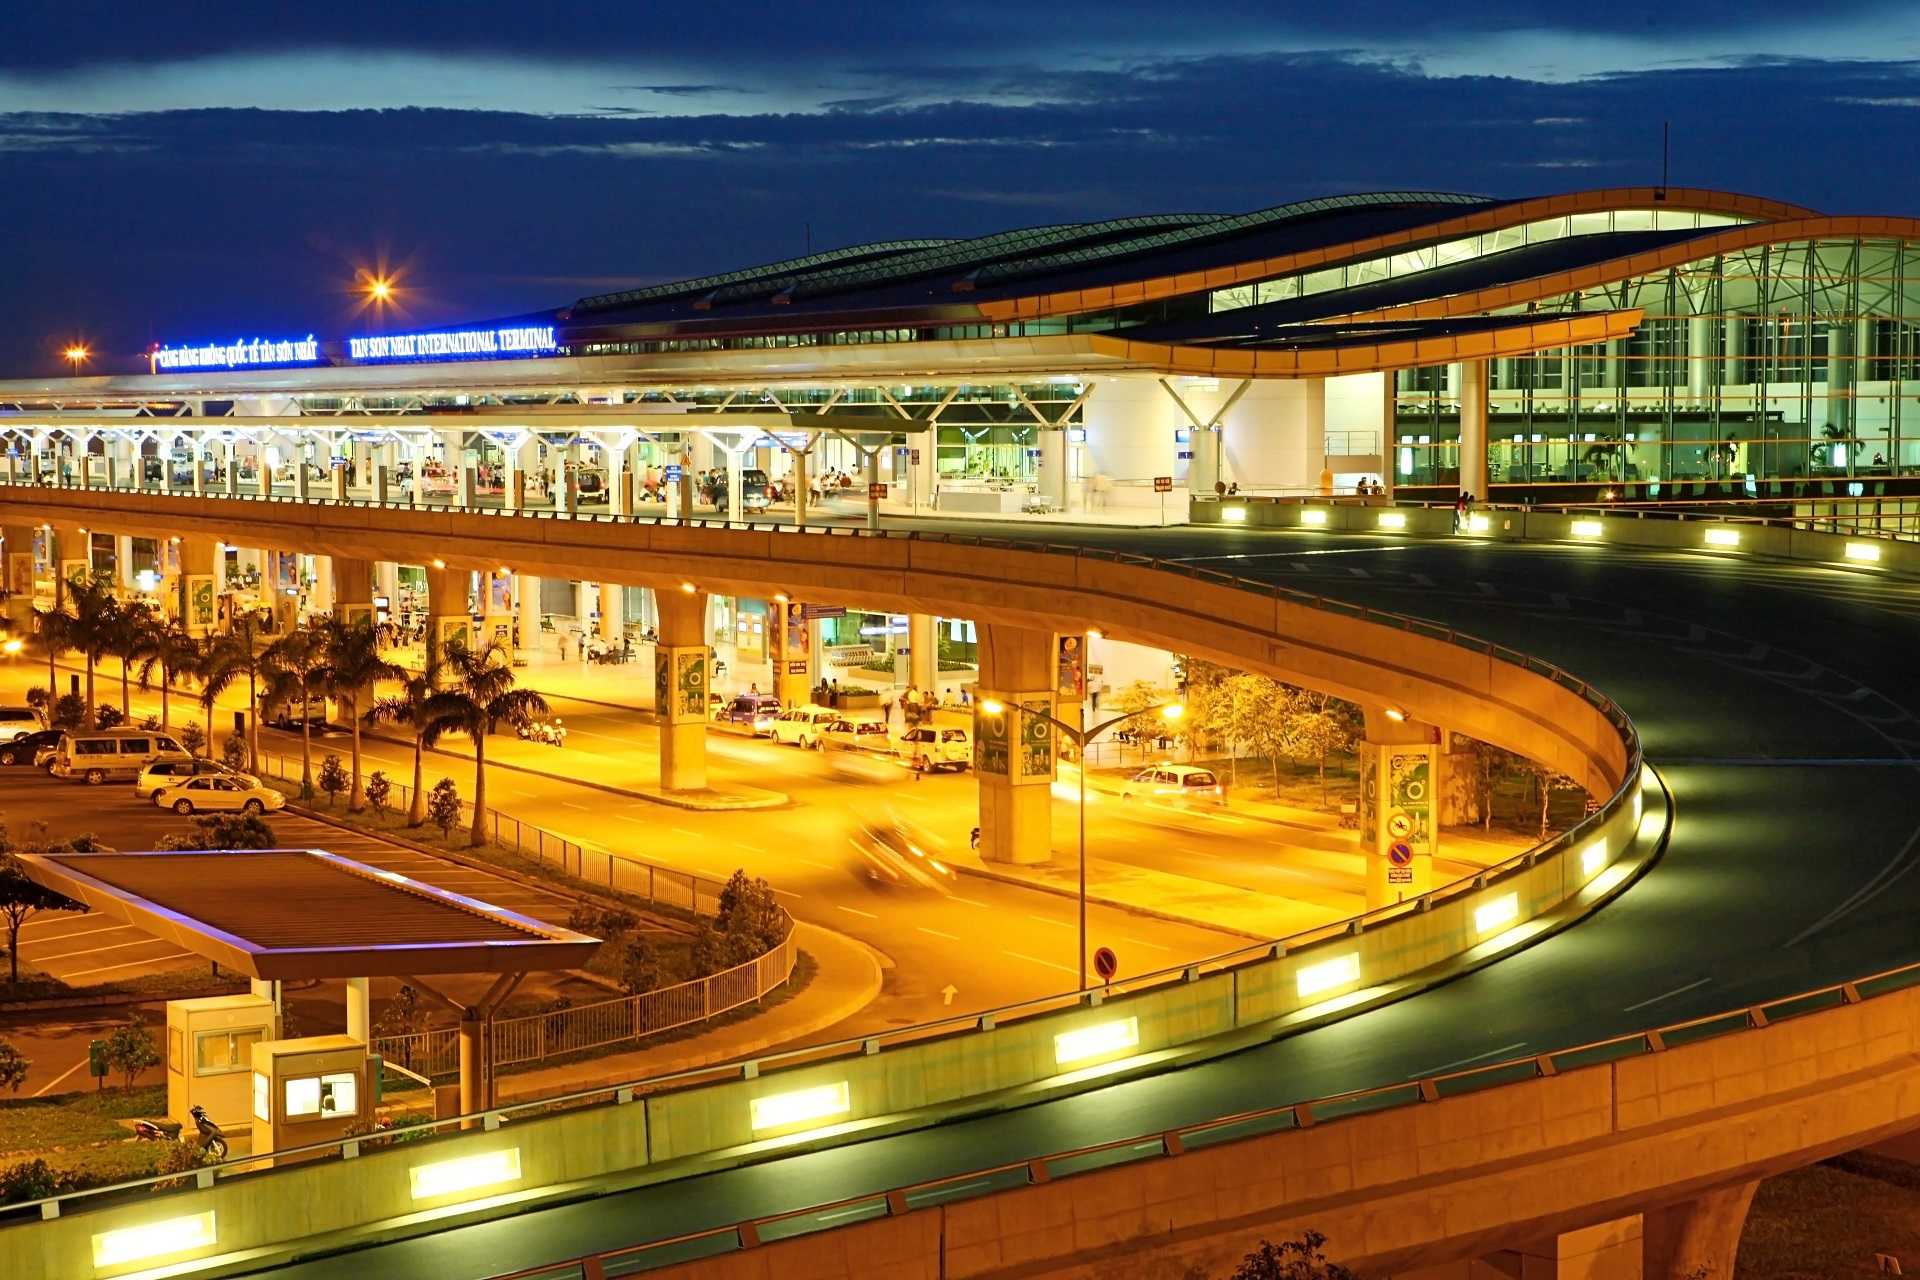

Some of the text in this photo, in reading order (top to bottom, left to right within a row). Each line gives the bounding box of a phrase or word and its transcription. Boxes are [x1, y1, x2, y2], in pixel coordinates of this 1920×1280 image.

[350, 327, 556, 358] TAN SON NHAT INTERNATIONAL TERMINAL
